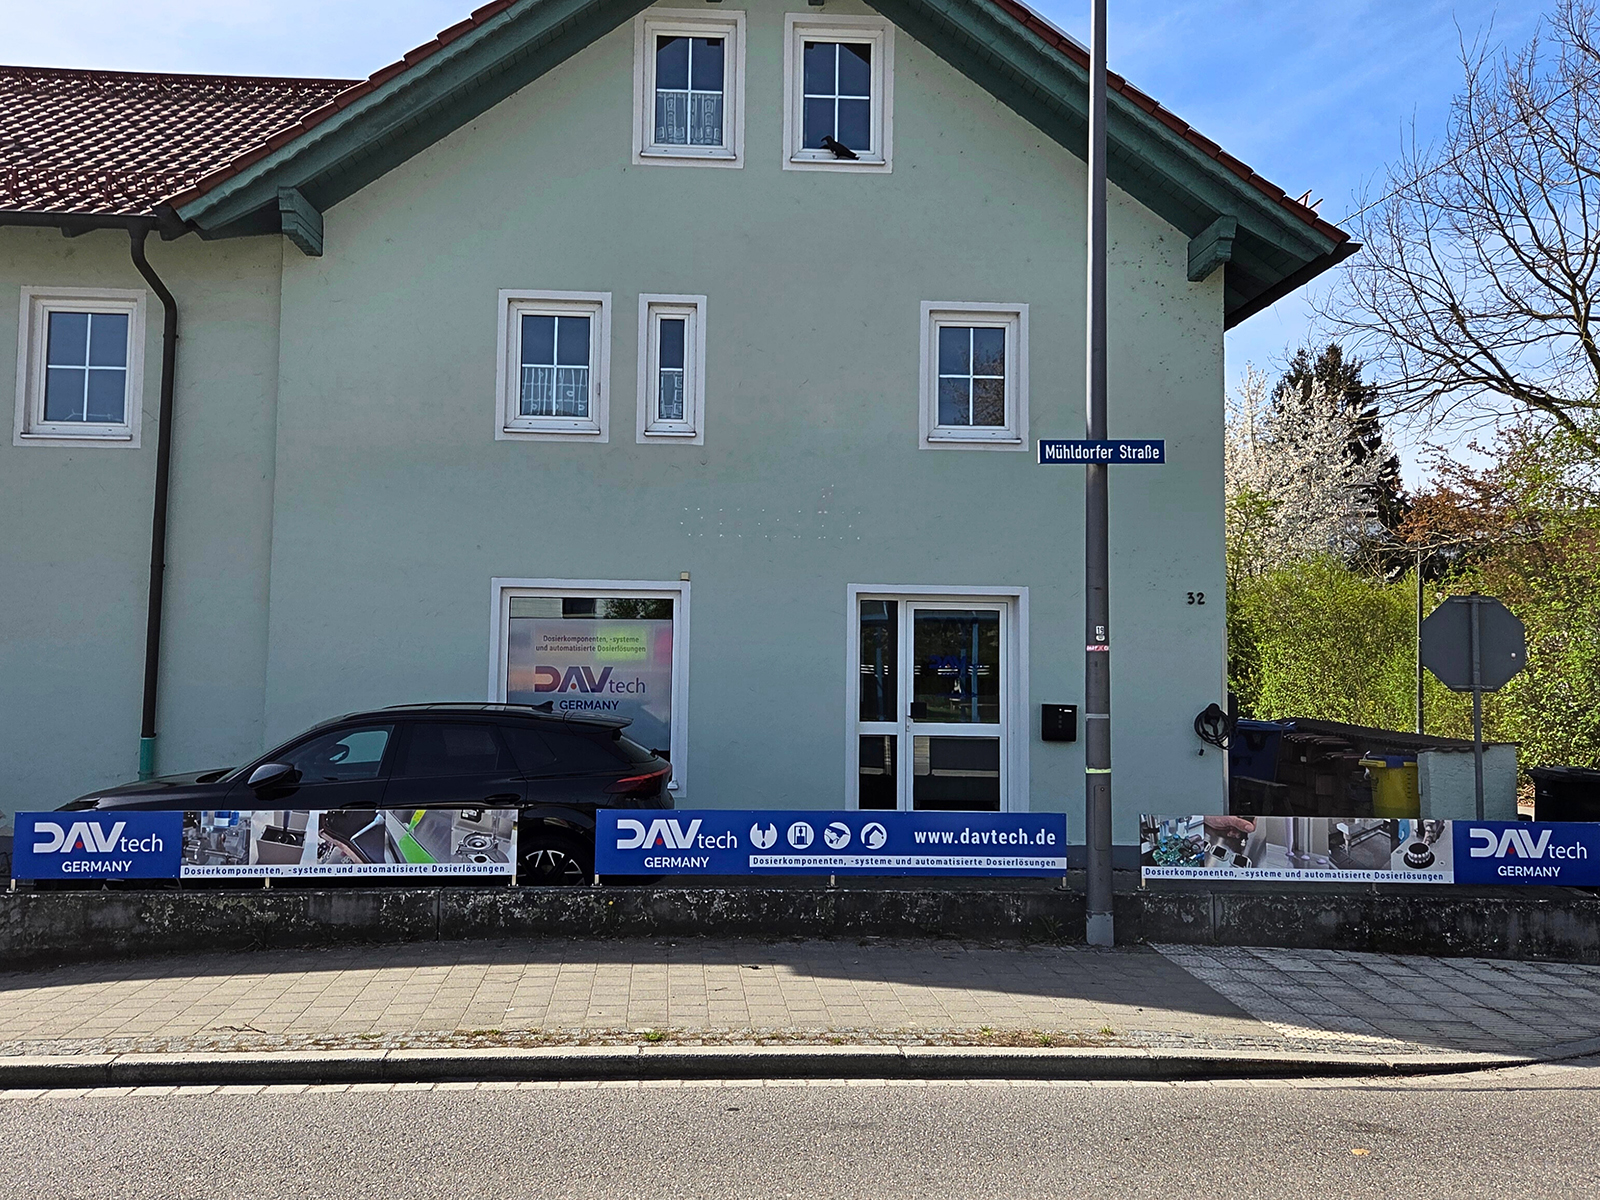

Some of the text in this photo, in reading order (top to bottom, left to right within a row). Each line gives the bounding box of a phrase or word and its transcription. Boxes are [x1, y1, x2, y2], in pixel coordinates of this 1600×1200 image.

[1045, 444, 1160, 459] Mühldorfer Straße
[1186, 591, 1206, 605] 32
[543, 635, 640, 644] Dosierkomponenten, -systeme
[535, 644, 646, 653] und automatisierte Dosierlösungen
[534, 665, 646, 693] DAVtech
[559, 700, 620, 710] GERMANY
[33, 821, 163, 853] DAVtech
[616, 819, 738, 849] DAVtech
[914, 827, 1056, 845] www.davtech.de
[1469, 828, 1588, 859] DAVtech
[61, 860, 132, 872] GERMANY
[644, 856, 710, 868] GERMANY
[752, 856, 1057, 867] Dosierkomponenten, -systeme und automatisierte Dosierlösungen
[184, 864, 505, 876] Dosierkomponenten, -systeme und automatisierte Dosierlösungen
[1145, 867, 1444, 881] Dosierkomponenten, -systeme und automatisierte Dosierlösungen
[1497, 865, 1561, 877] GERMANY
